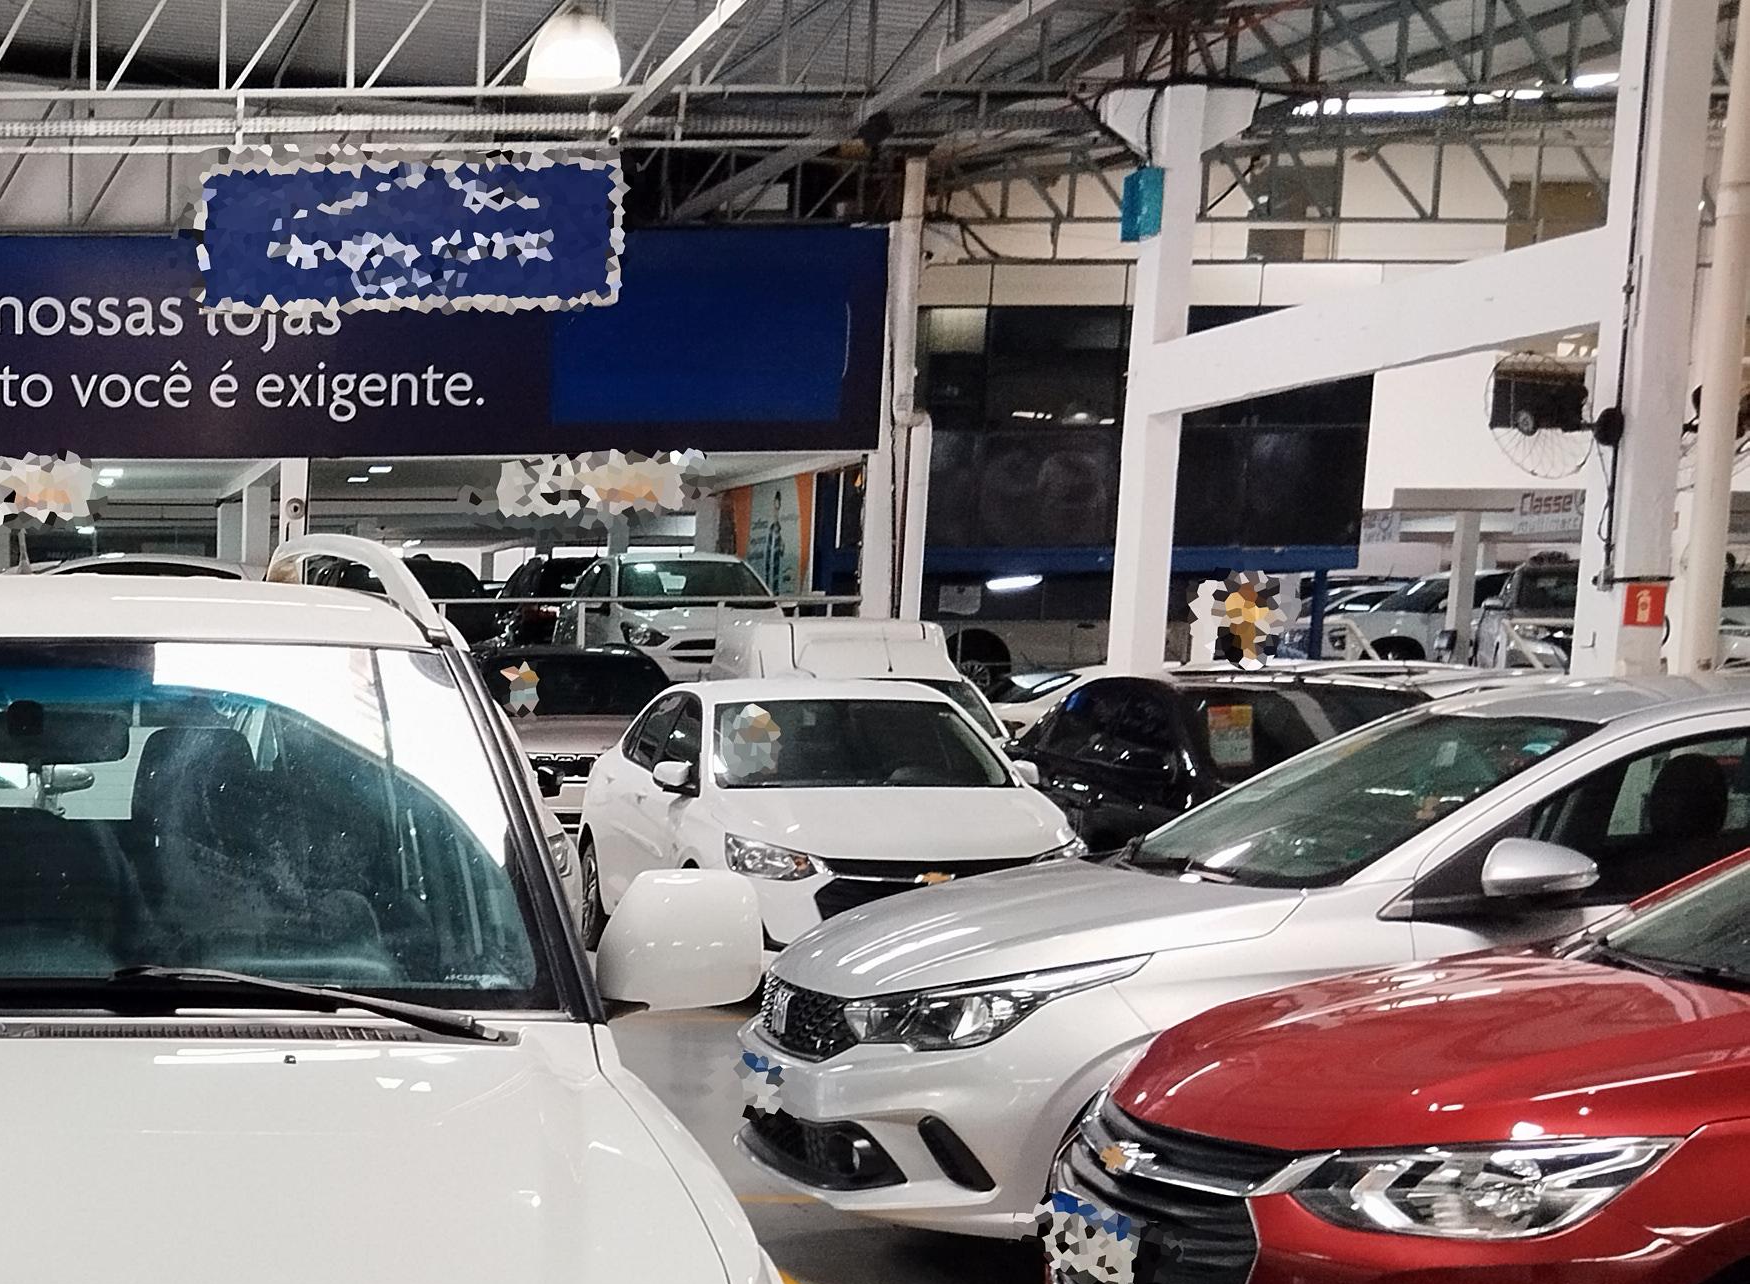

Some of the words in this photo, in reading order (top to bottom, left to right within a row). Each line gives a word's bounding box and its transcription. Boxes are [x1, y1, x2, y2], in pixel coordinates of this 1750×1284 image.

[71, 360, 192, 408] você
[210, 360, 239, 408] é
[256, 362, 485, 422] exigente.
[1520, 492, 1573, 516] Classe
